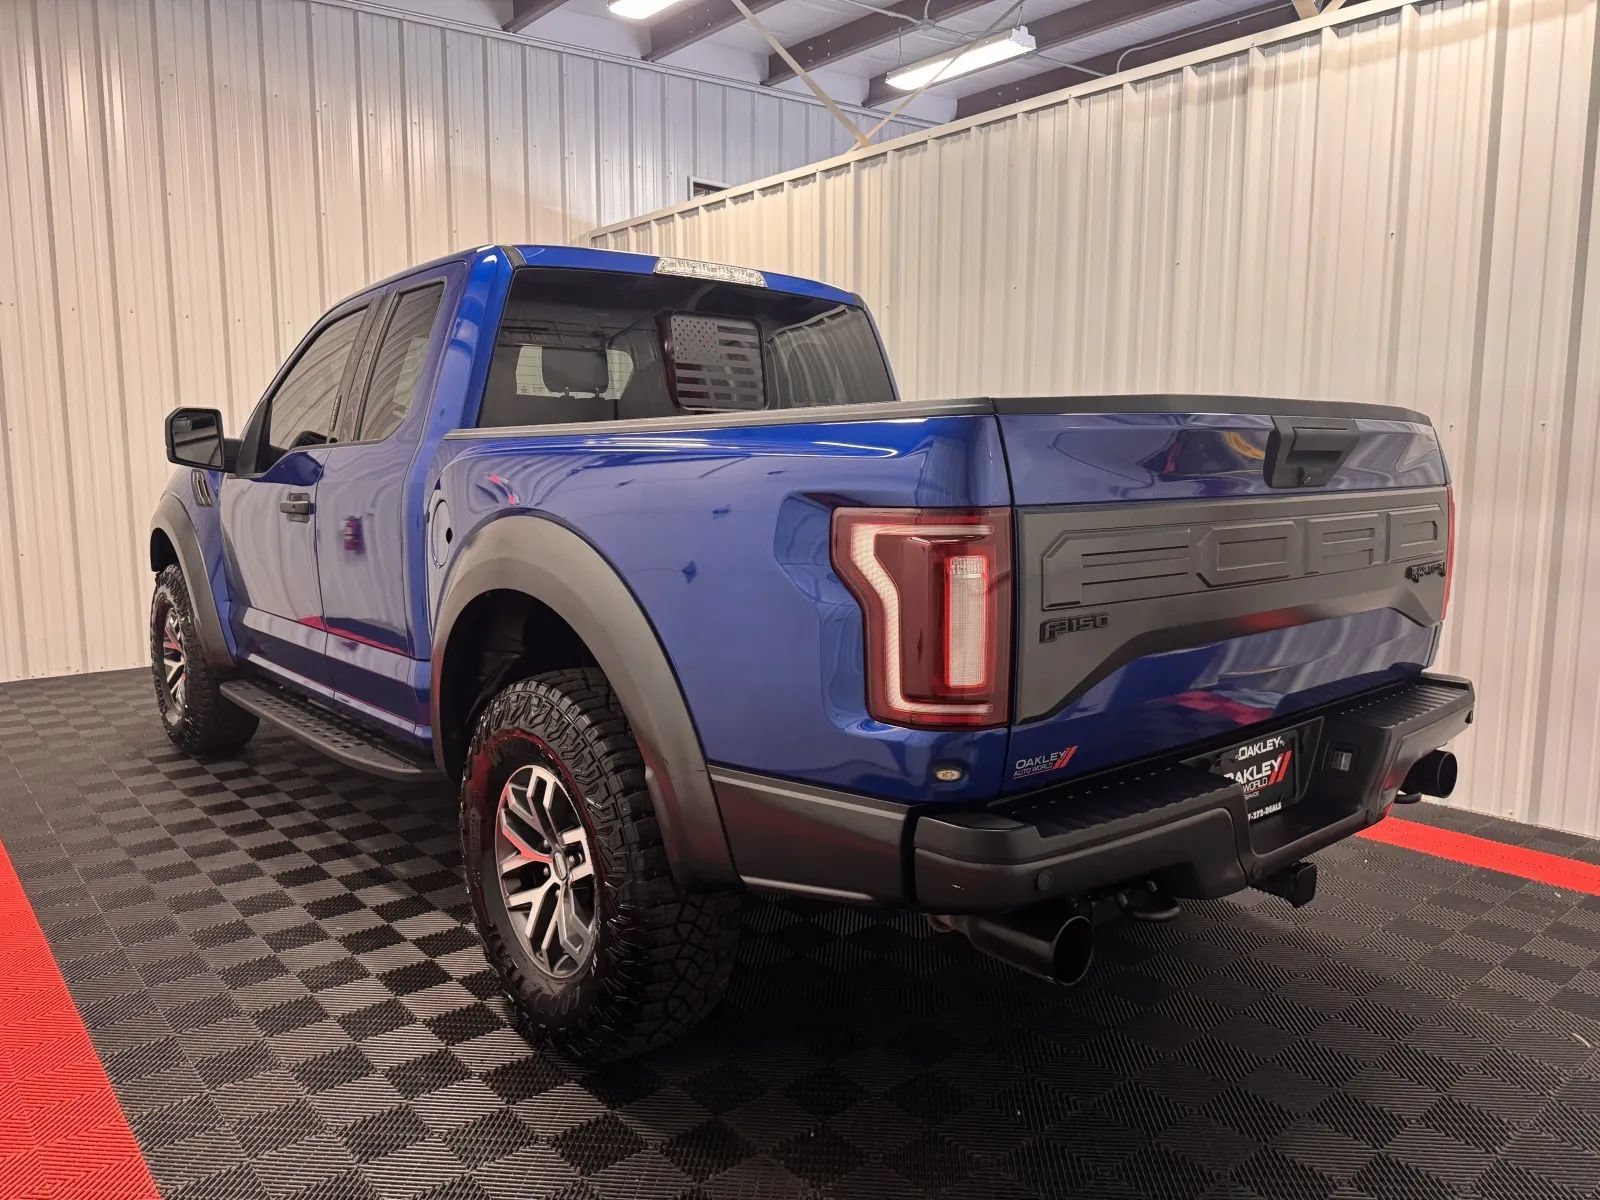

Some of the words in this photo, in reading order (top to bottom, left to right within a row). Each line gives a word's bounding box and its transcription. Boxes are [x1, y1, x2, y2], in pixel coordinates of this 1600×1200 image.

[1040, 504, 1446, 611] FORD
[1015, 747, 1070, 770] OAKLEY
[1237, 736, 1282, 761] OAKLEY
[1013, 767, 1031, 777] AUTO
[1031, 762, 1054, 773] WORLD
[1242, 776, 1268, 793] WORLD
